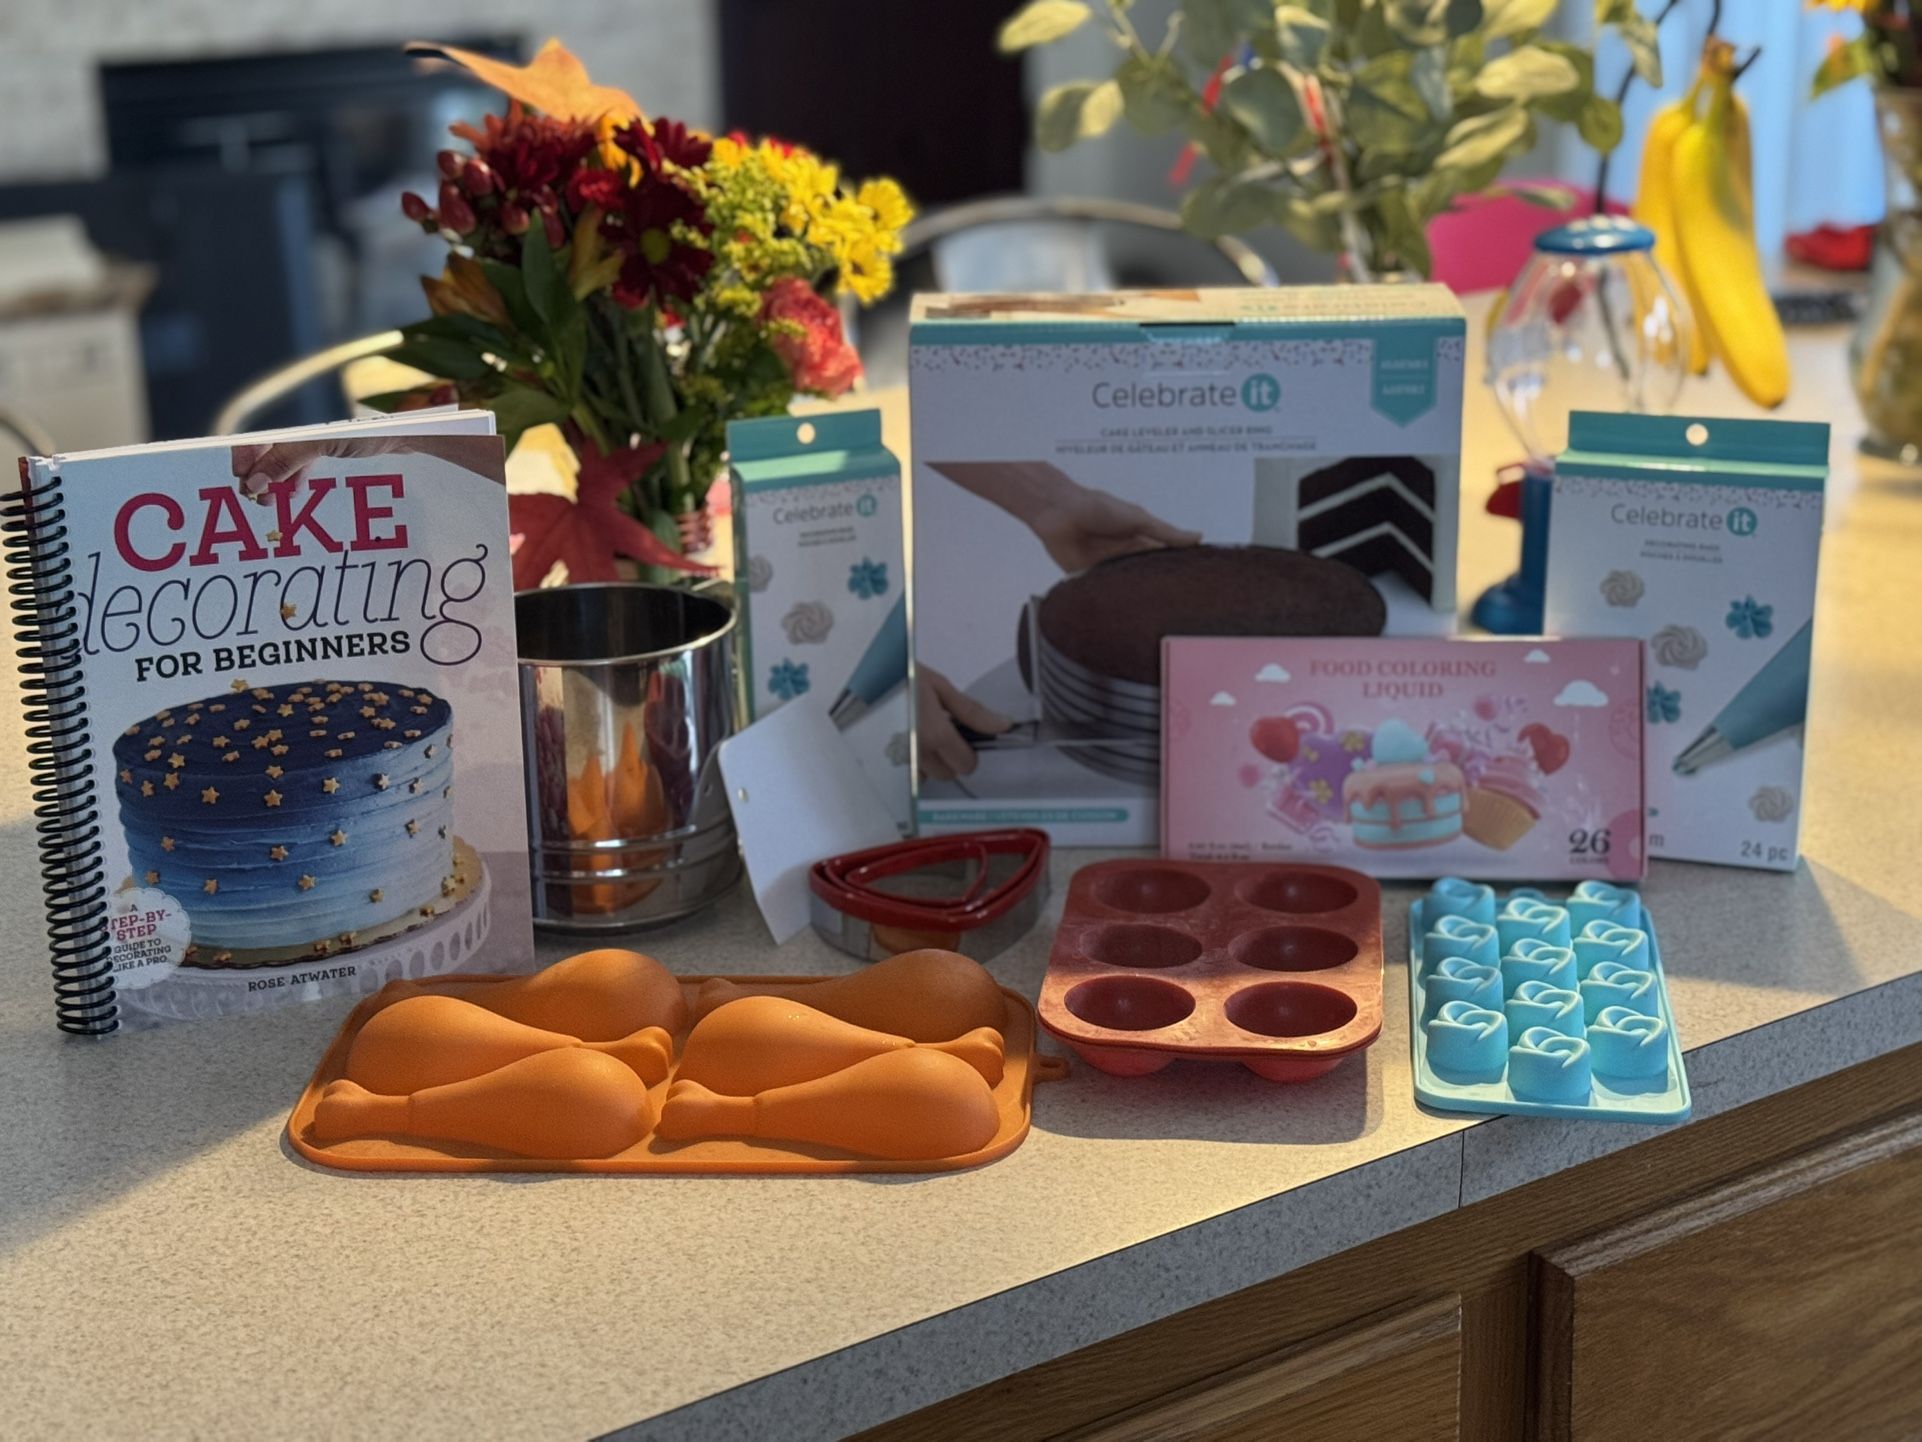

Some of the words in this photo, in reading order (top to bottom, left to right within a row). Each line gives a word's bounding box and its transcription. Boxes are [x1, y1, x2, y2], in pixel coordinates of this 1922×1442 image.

[1091, 381, 1237, 410] Celebrate
[114, 473, 409, 572] CAKE
[772, 502, 854, 526] Celebrate
[1610, 503, 1724, 531] Celebrate
[134, 651, 203, 682] FOR
[212, 630, 411, 672] BEGINNERS
[1309, 659, 1372, 677] FOOD
[1377, 658, 1497, 678] COLORING
[1362, 681, 1444, 700] LIQUID
[1568, 828, 1612, 855] 26
[1740, 840, 1763, 858] 24
[1767, 846, 1789, 863] pc
[129, 903, 138, 912] A
[116, 923, 157, 941] STEP
[114, 941, 146, 953] GUIDE
[147, 938, 162, 948] TO
[137, 959, 144, 968] A
[146, 955, 168, 967] PRO
[247, 976, 287, 992] ROSE
[291, 966, 357, 985] ATWATER
